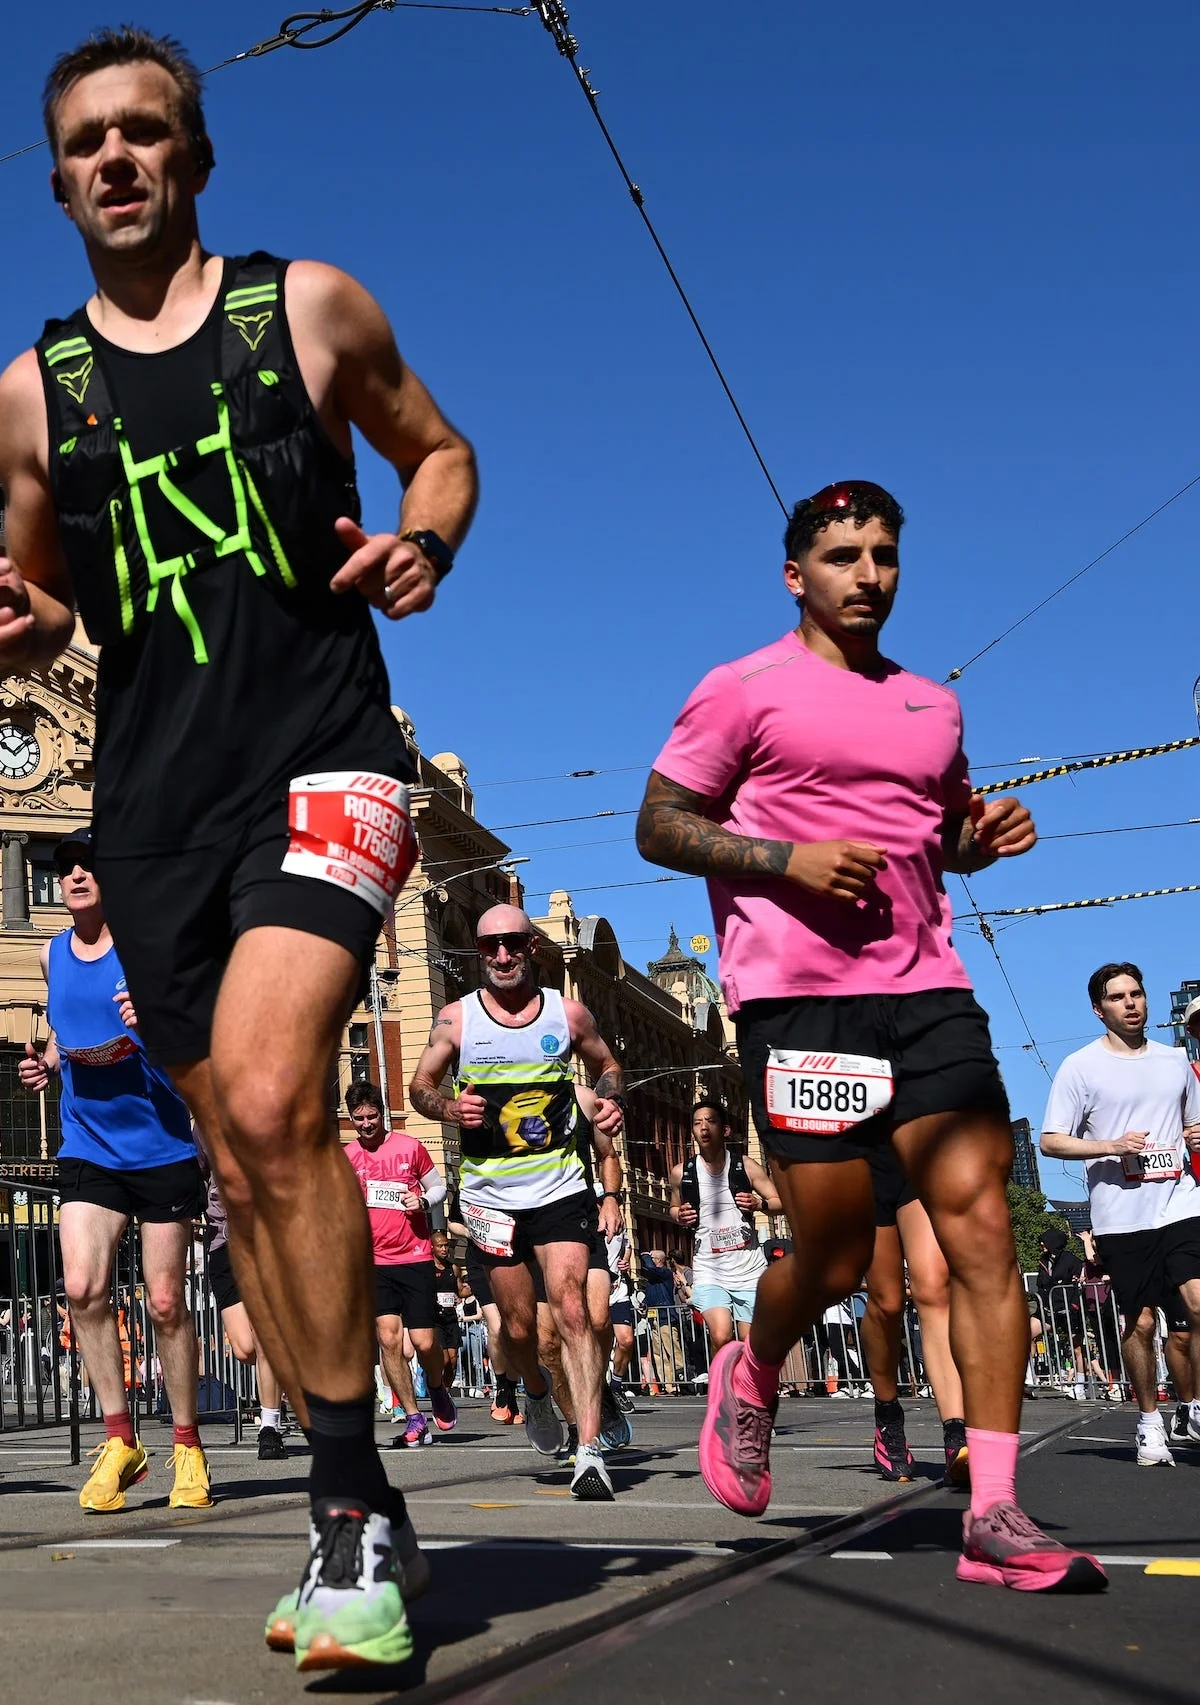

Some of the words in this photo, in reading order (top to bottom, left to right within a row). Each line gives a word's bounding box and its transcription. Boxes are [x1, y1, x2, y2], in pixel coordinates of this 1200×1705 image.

[344, 794, 407, 845] ROBERT
[353, 821, 399, 869] 17598
[327, 841, 386, 884] MELBOURNE
[691, 937, 707, 945] CUT
[693, 944, 708, 952] OFF
[768, 1074, 776, 1108] MARATHON
[787, 1078, 867, 1114] 15889
[785, 1117, 841, 1132] MELBOURNE
[0, 1163, 57, 1177] STREET
[1137, 1152, 1174, 1170] 14203
[375, 1189, 401, 1203] 12289
[467, 1216, 491, 1234] NORRO
